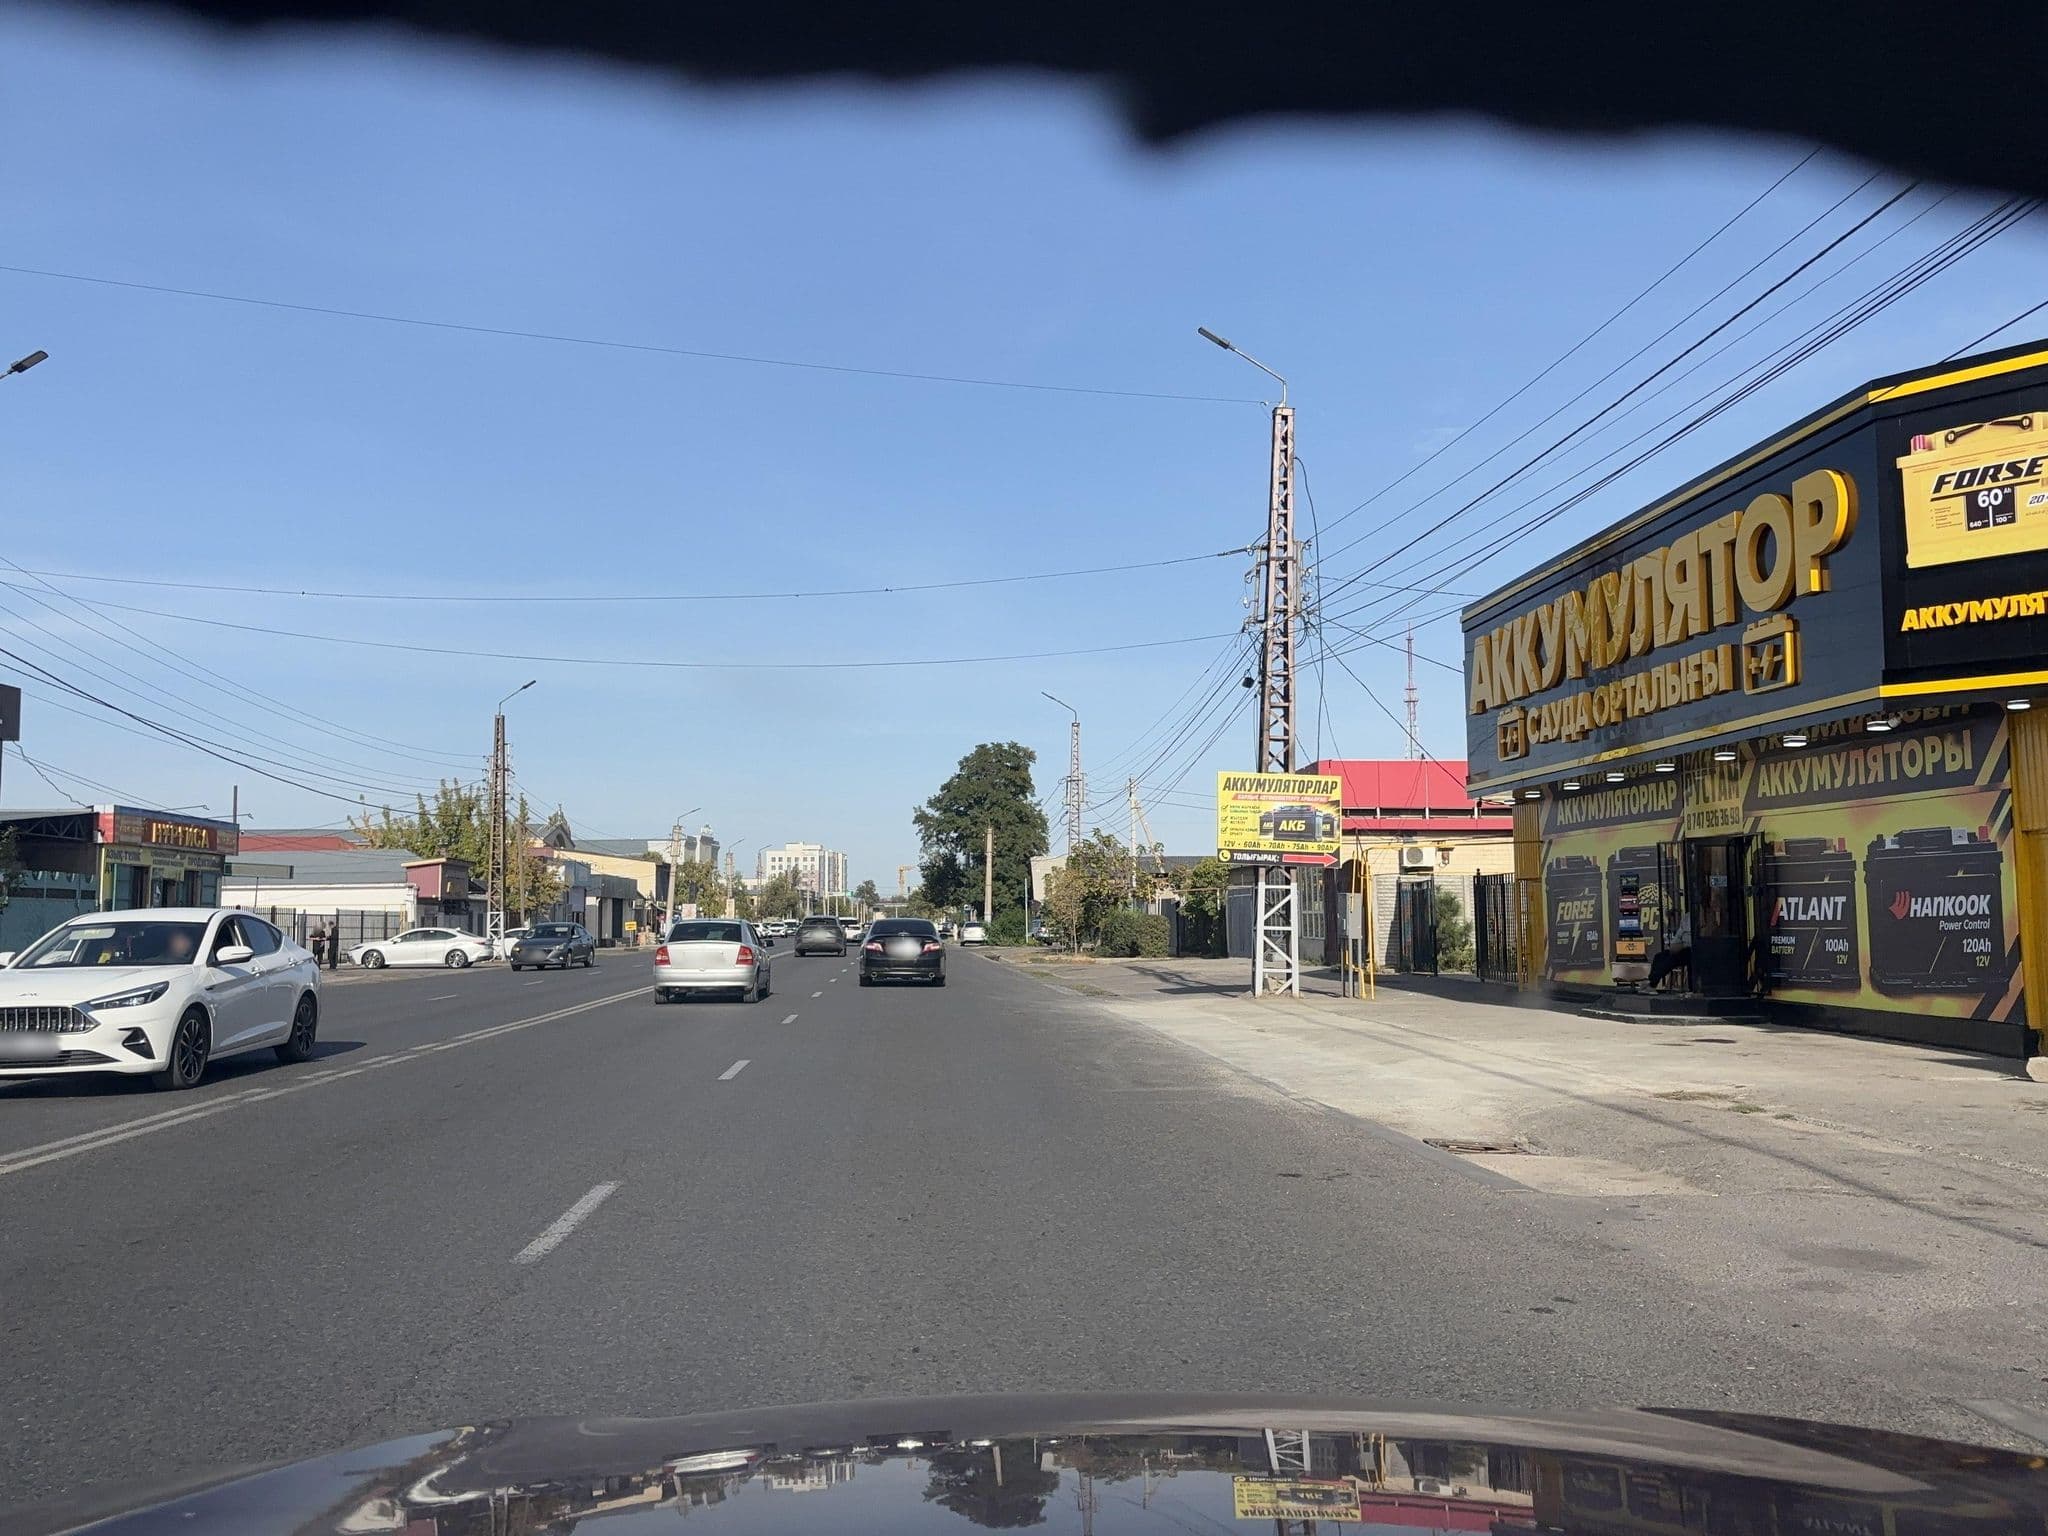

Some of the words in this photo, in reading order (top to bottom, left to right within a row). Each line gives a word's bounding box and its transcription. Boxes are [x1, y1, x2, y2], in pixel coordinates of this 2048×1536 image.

[1932, 455, 2048, 494] FORSE
[1977, 488, 2003, 508] 60
[2028, 494, 2048, 505] 20
[1468, 469, 1858, 715] АККУМУЛЯТОР
[1526, 692, 1593, 746] САУДА
[1592, 644, 1739, 727] ОРТАЛЫҒЫ
[1757, 729, 1973, 799] АККУМУЛЯТОРЫ
[1223, 777, 1338, 794] АККУМУЛЯТОРЛАР
[1556, 779, 1678, 826] АККУМУЛЯТОРЛАР
[1279, 820, 1306, 831] АКБ
[1223, 840, 1235, 848] 12V
[1269, 842, 1286, 850] 70Ah
[1557, 899, 1595, 921] FORSE
[1770, 896, 1847, 927] ATLANT
[1939, 919, 1963, 932] Power
[1963, 918, 1991, 930] Control
[1771, 935, 1796, 945] PREMIUM
[1825, 939, 1849, 952] 100Ah
[1962, 938, 1992, 954] 120Ah
[1975, 955, 1991, 967] 12V
